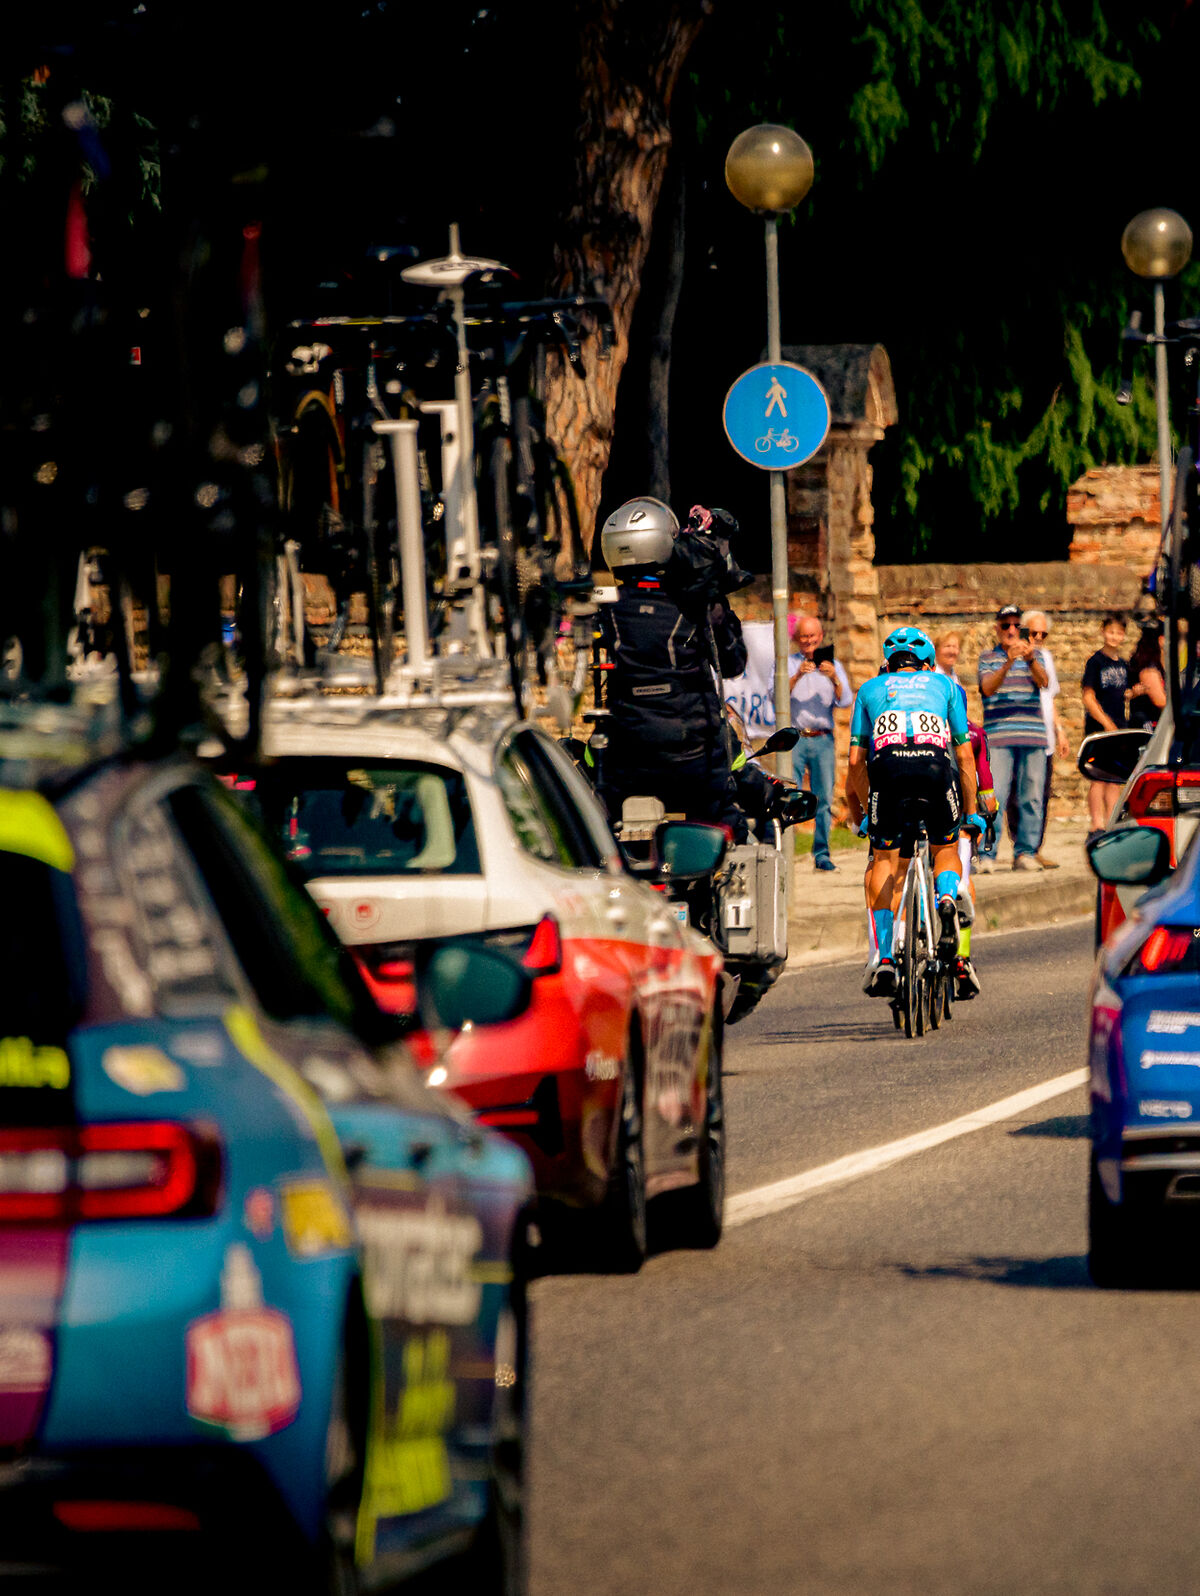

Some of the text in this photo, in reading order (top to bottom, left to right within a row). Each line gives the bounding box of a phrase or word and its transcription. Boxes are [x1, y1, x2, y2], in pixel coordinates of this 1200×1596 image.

[877, 712, 898, 735] 88
[919, 713, 941, 734] 88
[876, 733, 901, 748] enel
[917, 733, 945, 749] enel
